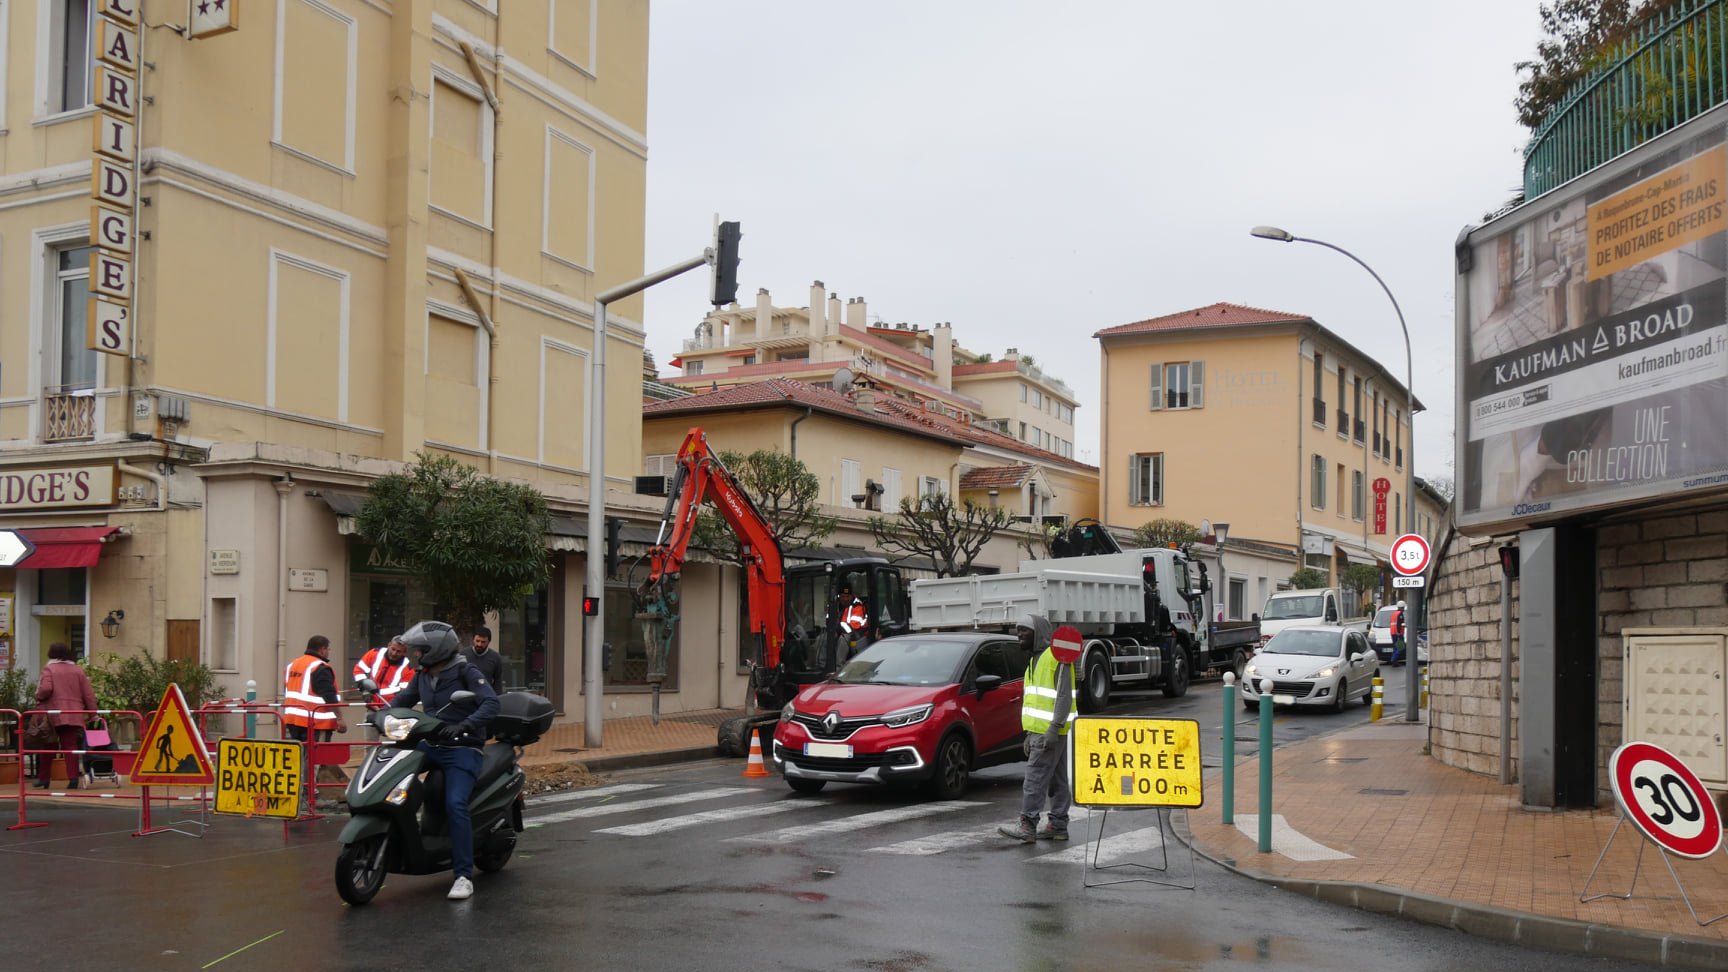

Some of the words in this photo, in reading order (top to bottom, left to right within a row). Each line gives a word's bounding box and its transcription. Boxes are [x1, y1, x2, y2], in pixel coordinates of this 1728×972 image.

[1596, 208, 1649, 245] PROFITEZ
[1652, 196, 1676, 222] DES
[1679, 179, 1717, 210] FRAIS
[1596, 248, 1611, 267] DE
[1615, 226, 1664, 259] NOTAIRE
[1495, 338, 1586, 385] KAUFMAN
[1615, 303, 1694, 347] BROAD
[1618, 334, 1728, 380] kaufmanbroad.fr
[1634, 406, 1671, 444] UNE
[1567, 442, 1668, 483] COLLECTION
[1376, 481, 1387, 533] HOTEL
[1511, 502, 1551, 516] JCDecaux
[1098, 728, 1175, 745] ROUTE
[227, 745, 292, 770] ROUTE
[1089, 750, 1186, 770] BARRÉE
[222, 769, 297, 795] BARRÉE
[1092, 774, 1106, 794] À
[1121, 776, 1168, 795] 00
[1174, 785, 1188, 795] m
[1634, 773, 1700, 825] 30
[267, 796, 279, 810] M
